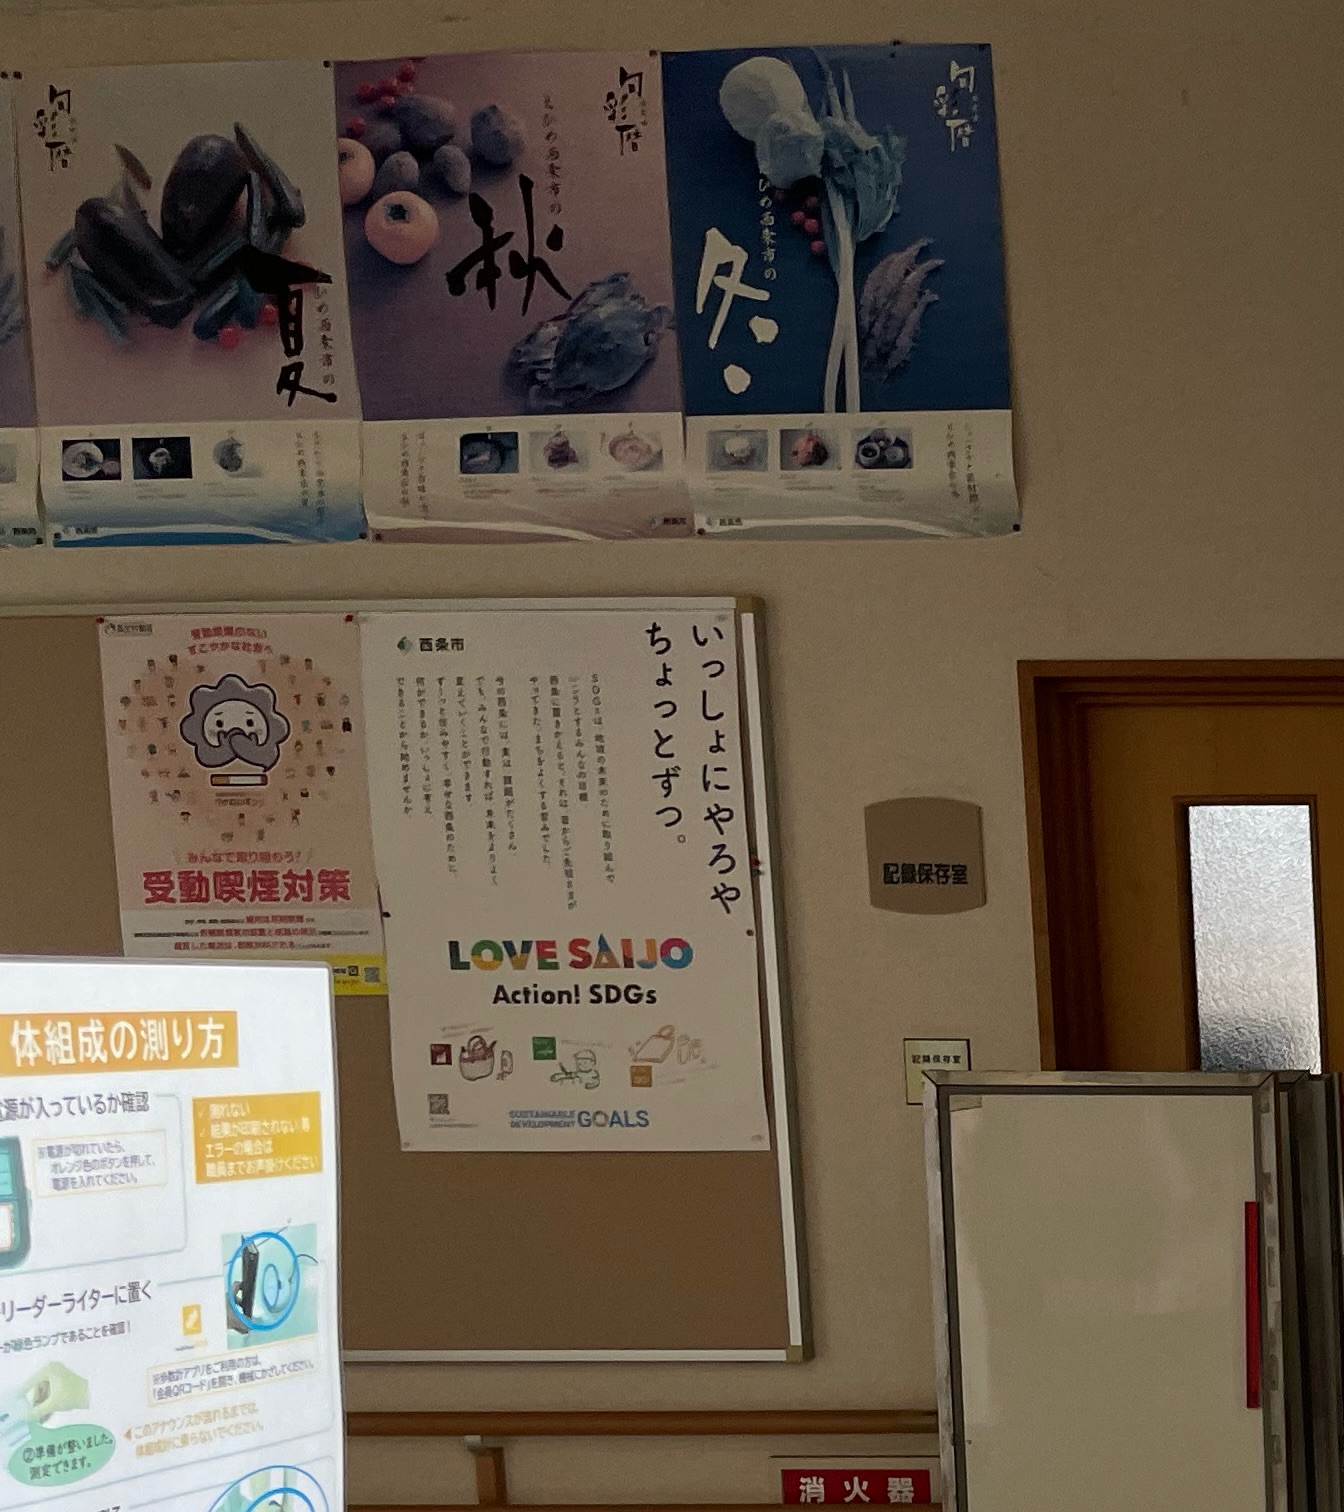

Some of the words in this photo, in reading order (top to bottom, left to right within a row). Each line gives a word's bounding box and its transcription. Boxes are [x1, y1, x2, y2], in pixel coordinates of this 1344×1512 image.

[446, 173, 572, 316] 秋
[239, 244, 338, 406] 夏
[696, 227, 778, 394] 冬
[419, 638, 465, 652] 西条市
[646, 622, 687, 844] ちょっとずつ。
[693, 625, 741, 914] いっしょにやろや
[142, 869, 351, 904] 受動喫煙対策
[883, 863, 968, 885] 記録保存室
[448, 939, 560, 971] LOVE
[569, 933, 693, 970] SAIJO
[493, 984, 580, 1005] Action!
[589, 984, 657, 1005] SDGs
[11, 1017, 225, 1067] 体組成の測り方
[578, 1110, 650, 1128] GOALS
[1, 1281, 152, 1323] リーダーライターに置く
[800, 1476, 914, 1503] 消火器
